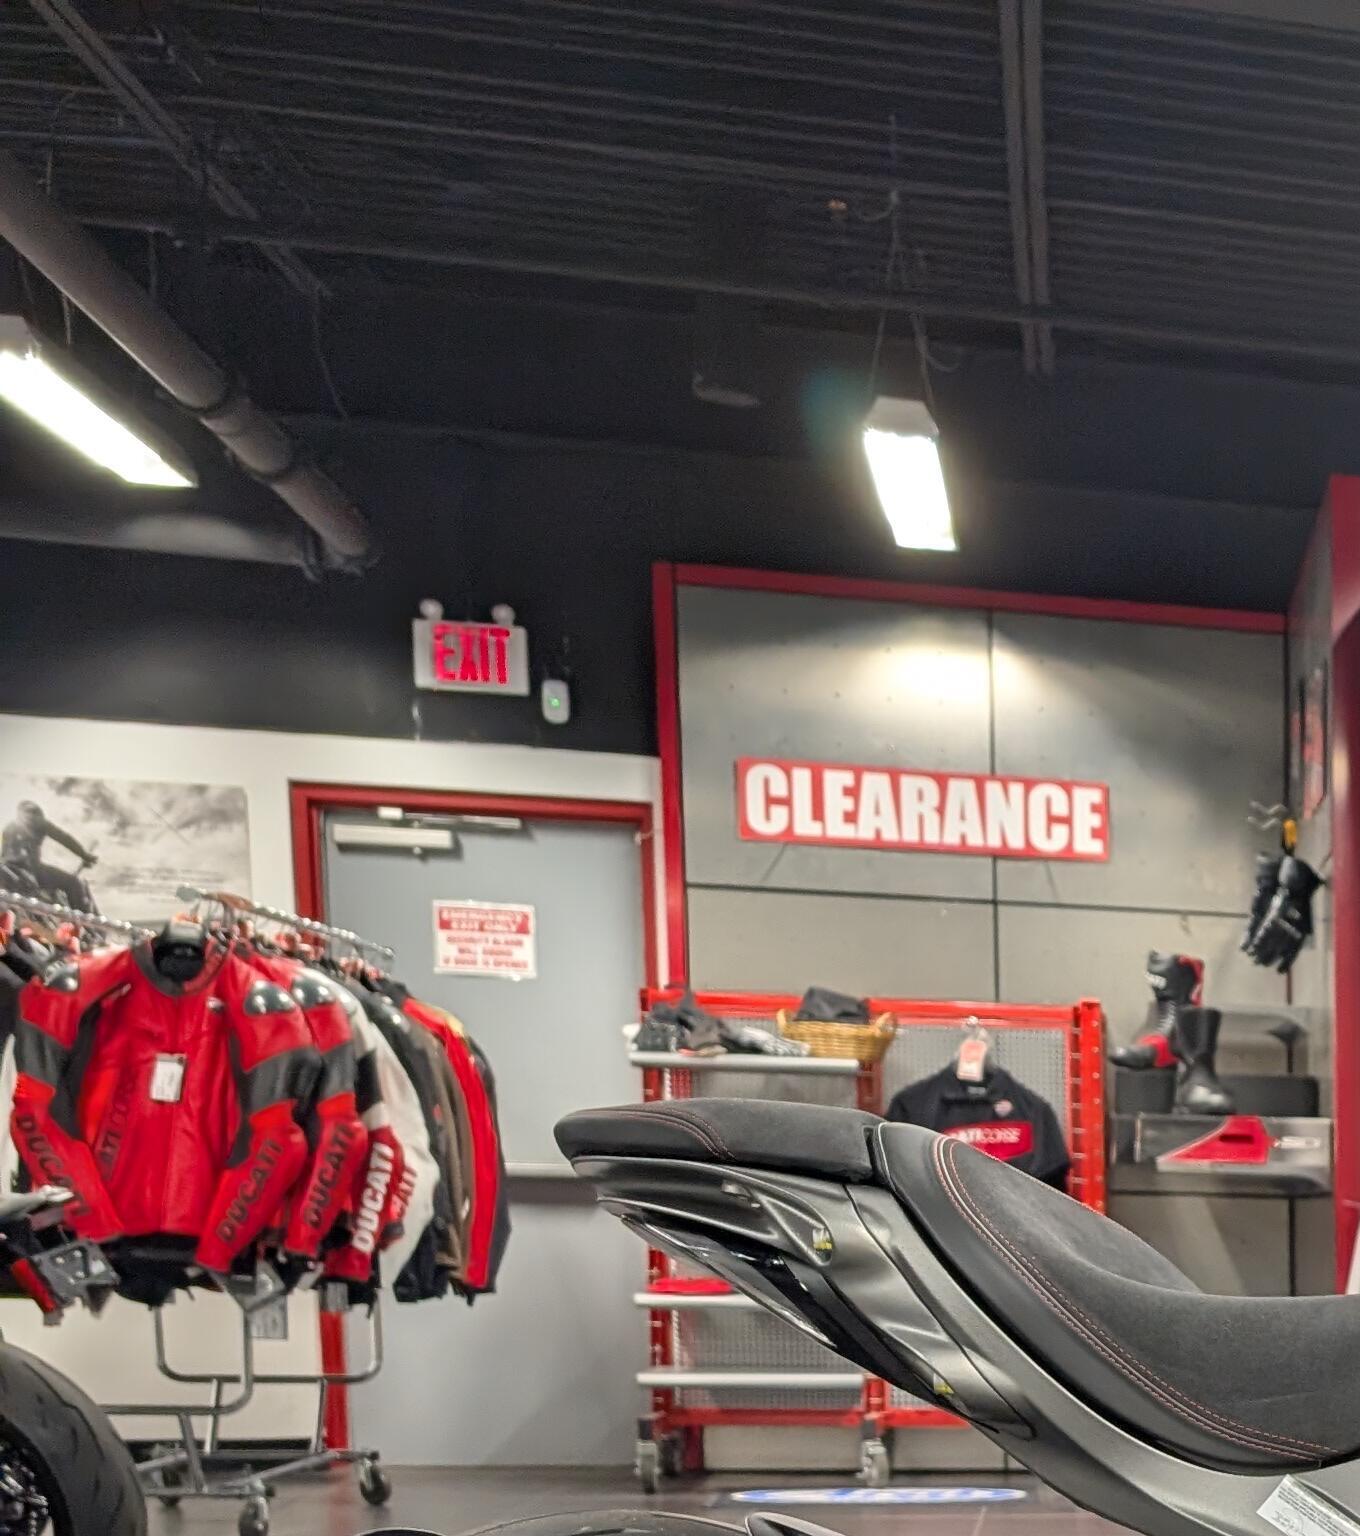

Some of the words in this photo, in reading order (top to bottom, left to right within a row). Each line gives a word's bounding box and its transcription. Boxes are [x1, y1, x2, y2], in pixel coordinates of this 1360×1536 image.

[433, 624, 510, 684] EXIT
[745, 763, 1106, 855] CLEARANCE
[216, 1140, 282, 1244] DUCATI
[303, 1122, 356, 1229] DUCATI
[352, 1141, 395, 1252] DUCATI
